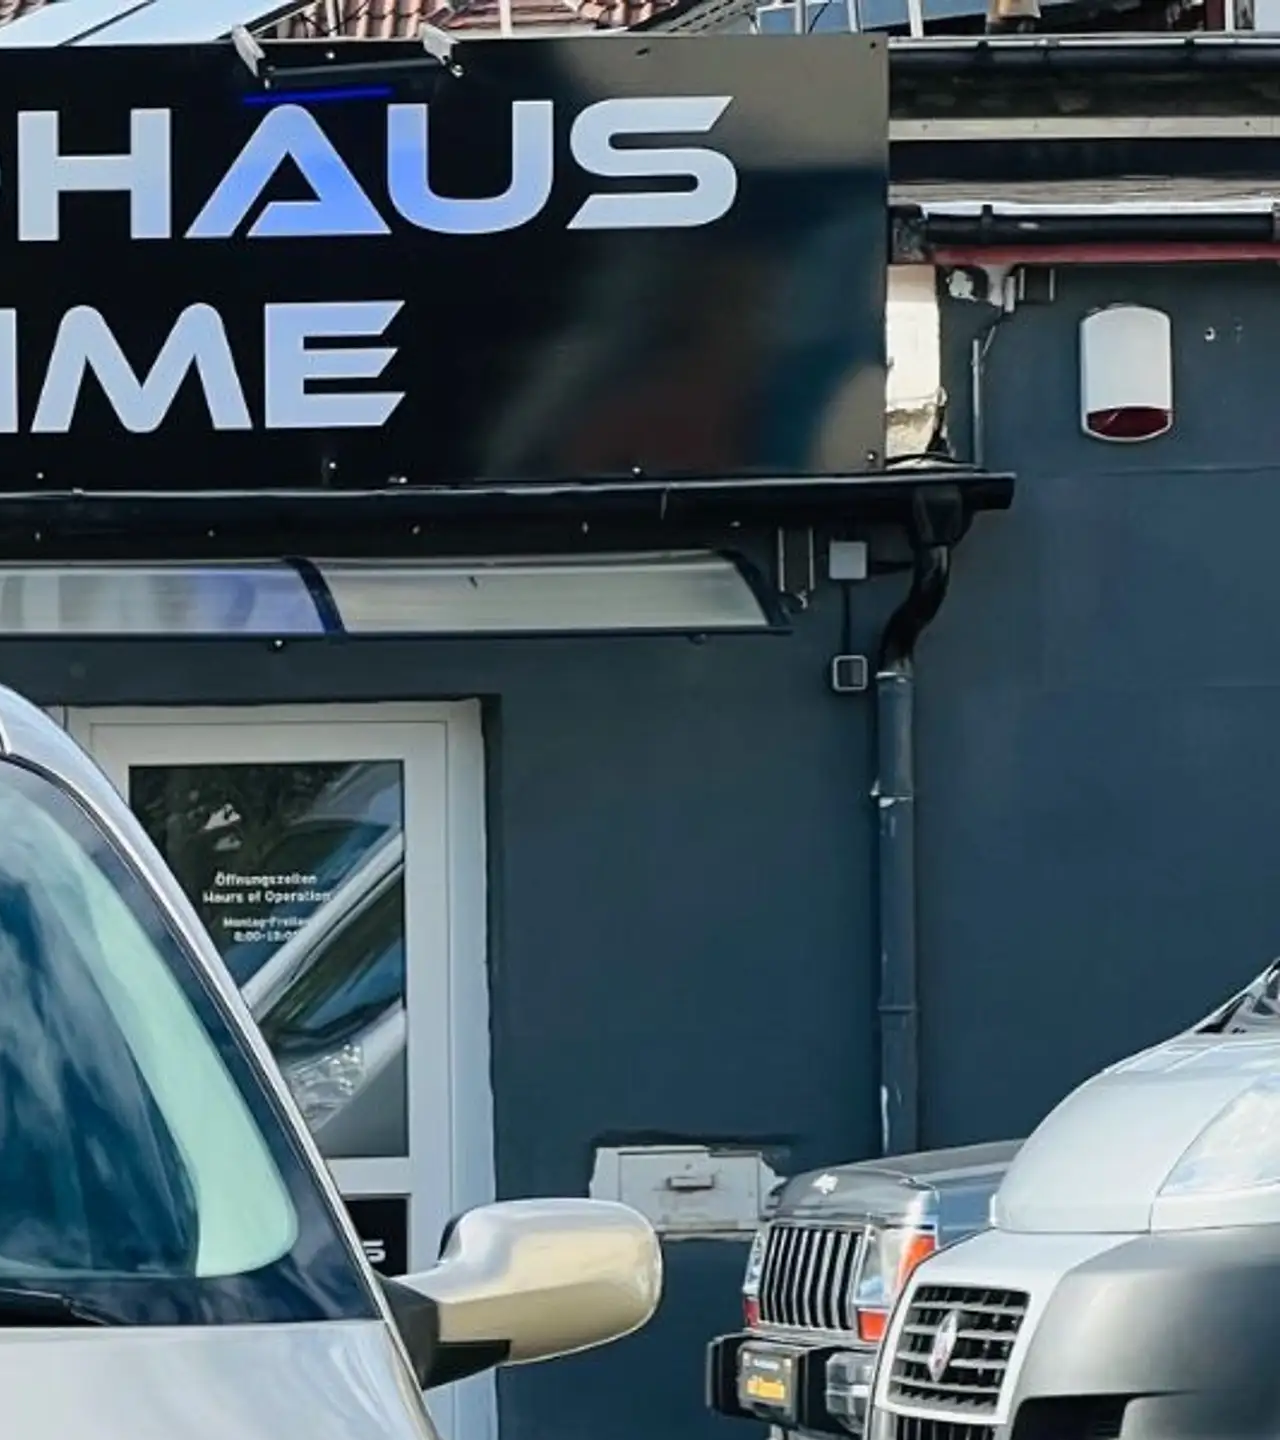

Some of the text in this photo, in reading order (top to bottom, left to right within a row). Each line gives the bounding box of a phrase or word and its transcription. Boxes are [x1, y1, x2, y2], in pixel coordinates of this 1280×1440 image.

[214, 871, 318, 888] Öffnungszeiten
[202, 891, 244, 903] Hours
[248, 890, 261, 903] of
